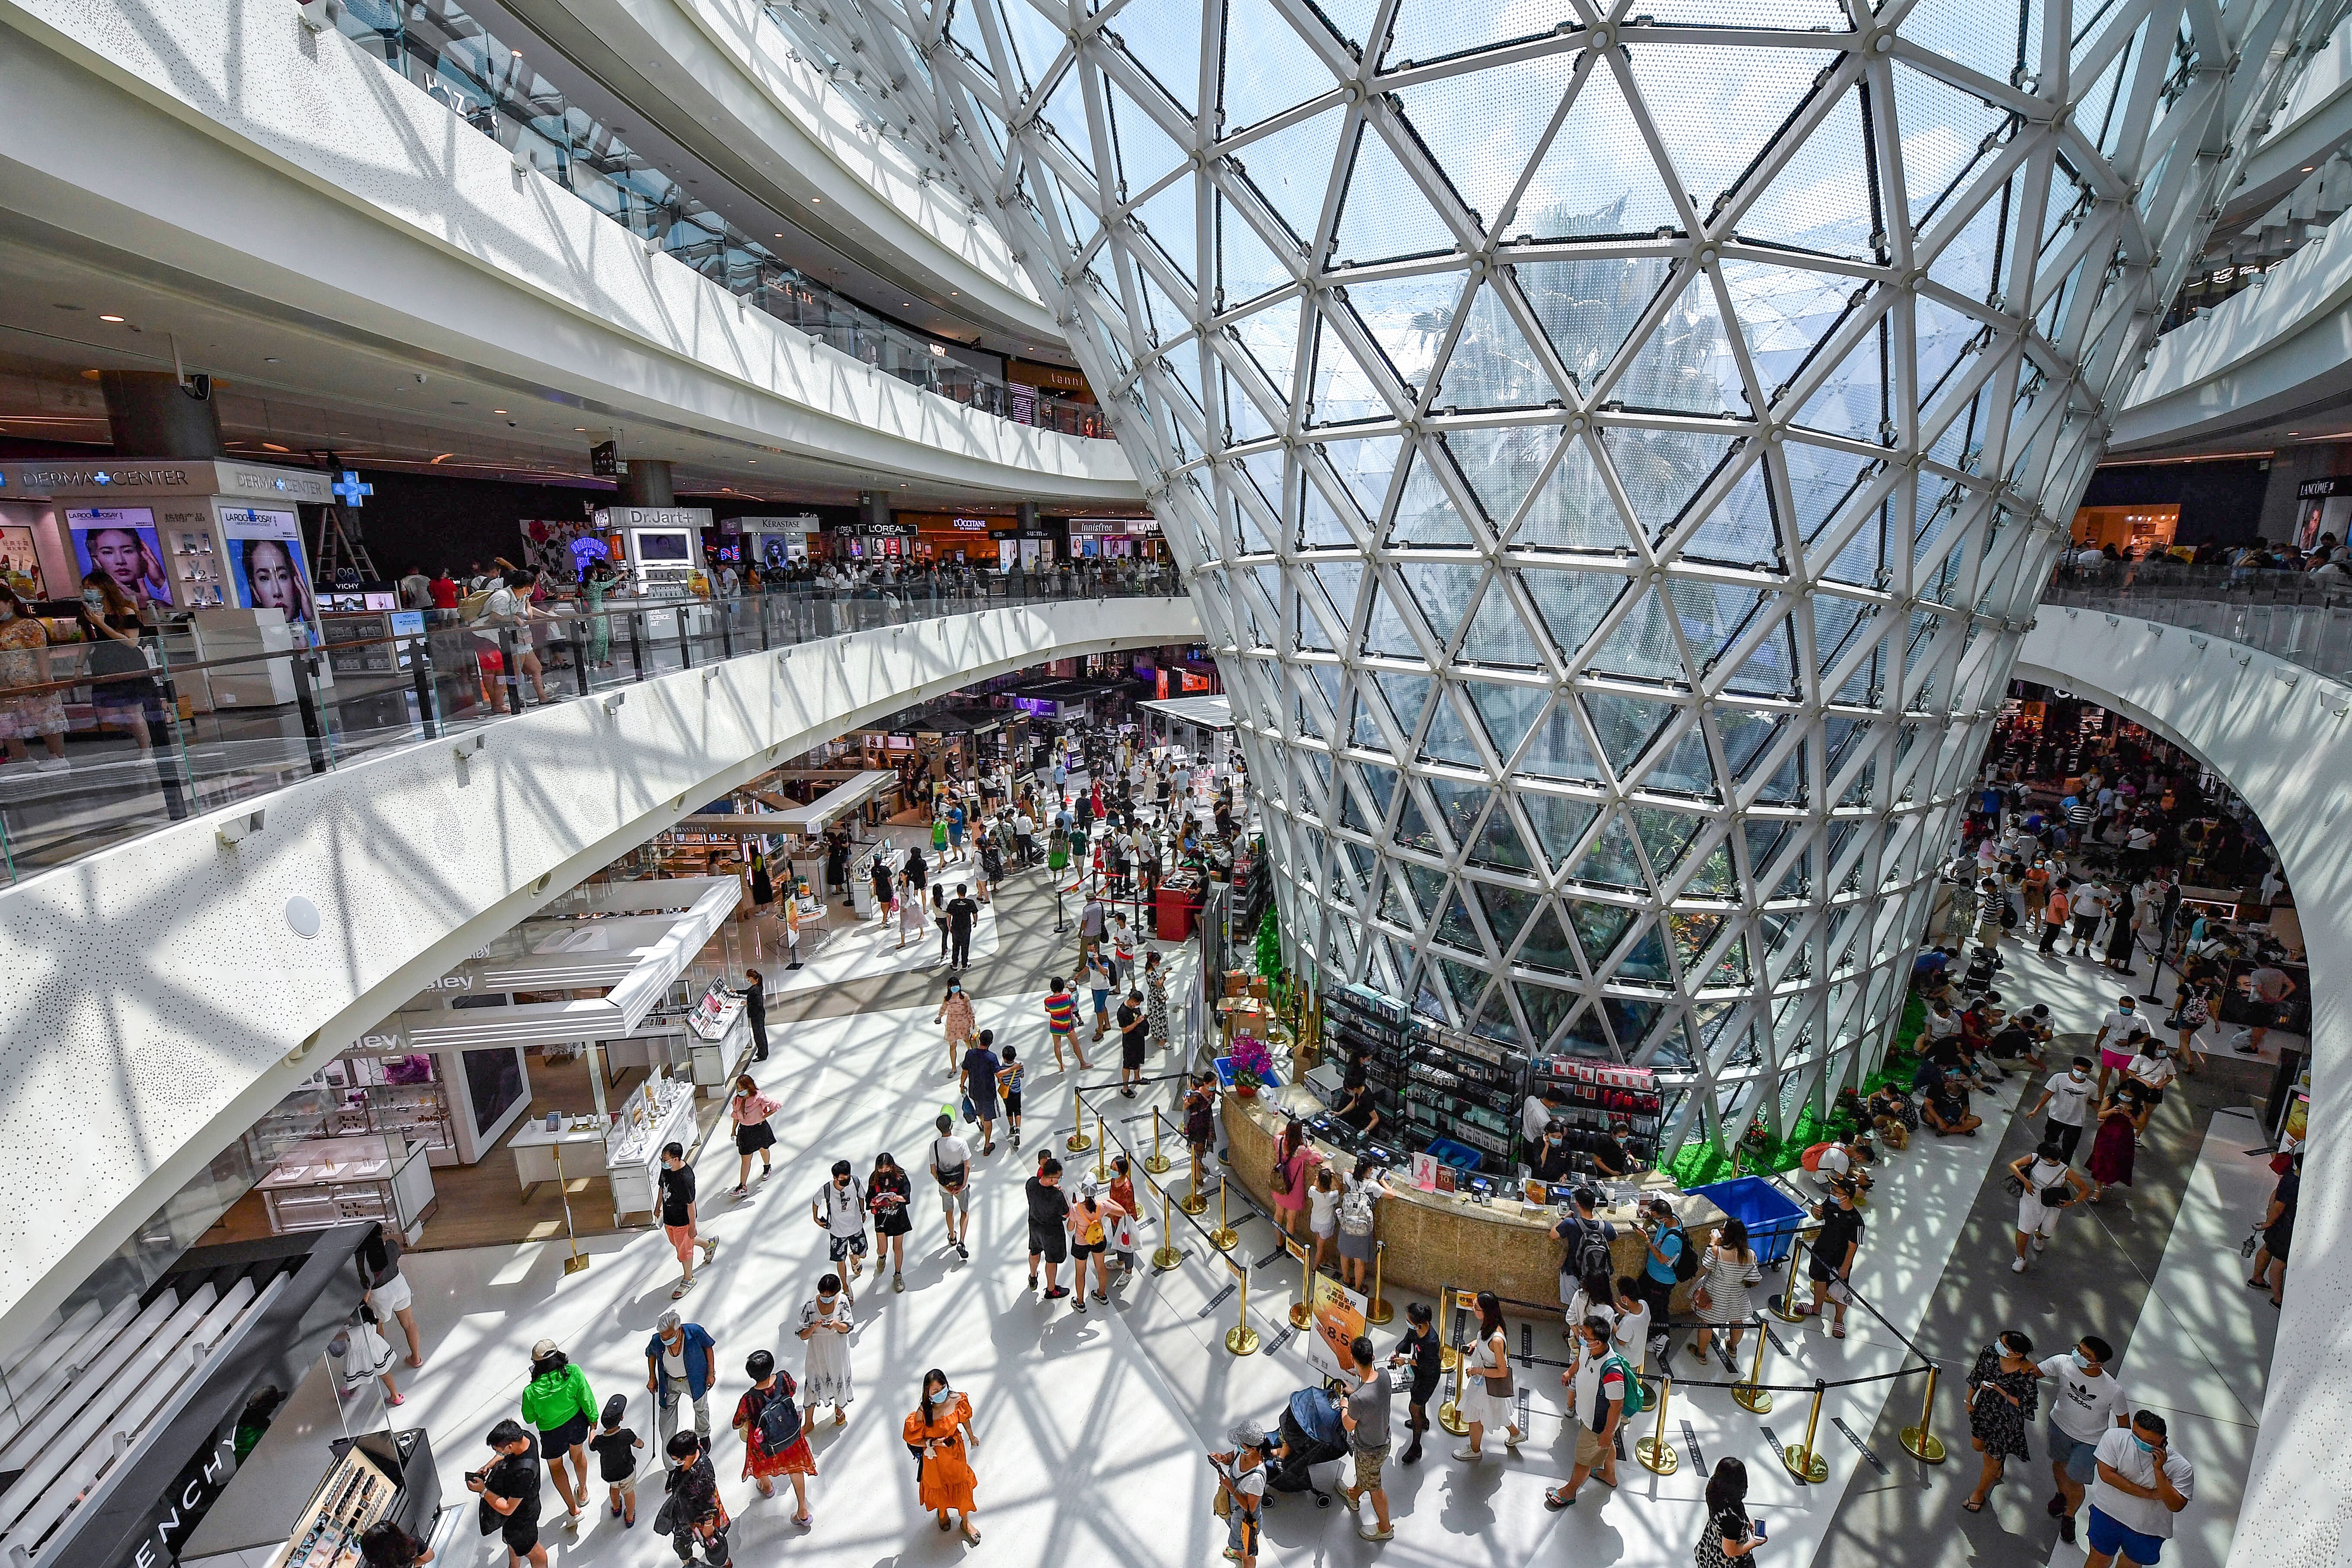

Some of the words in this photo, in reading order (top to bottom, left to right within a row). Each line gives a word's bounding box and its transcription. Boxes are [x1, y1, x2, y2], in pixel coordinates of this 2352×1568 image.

[23, 471, 95, 487] DERMA
[113, 470, 189, 486] CENTER
[236, 472, 276, 489] DERMA
[283, 478, 322, 495] CENTER
[2300, 481, 2329, 496] LANCÔME
[630, 511, 693, 523] Dr.Jart+
[762, 519, 800, 528] KÉRASTASE
[954, 518, 986, 527] L'OCCITANE
[570, 537, 608, 555] PURVEYORS
[1327, 1326, 1349, 1347] 8.5
[2067, 1393, 2092, 1410] adidas
